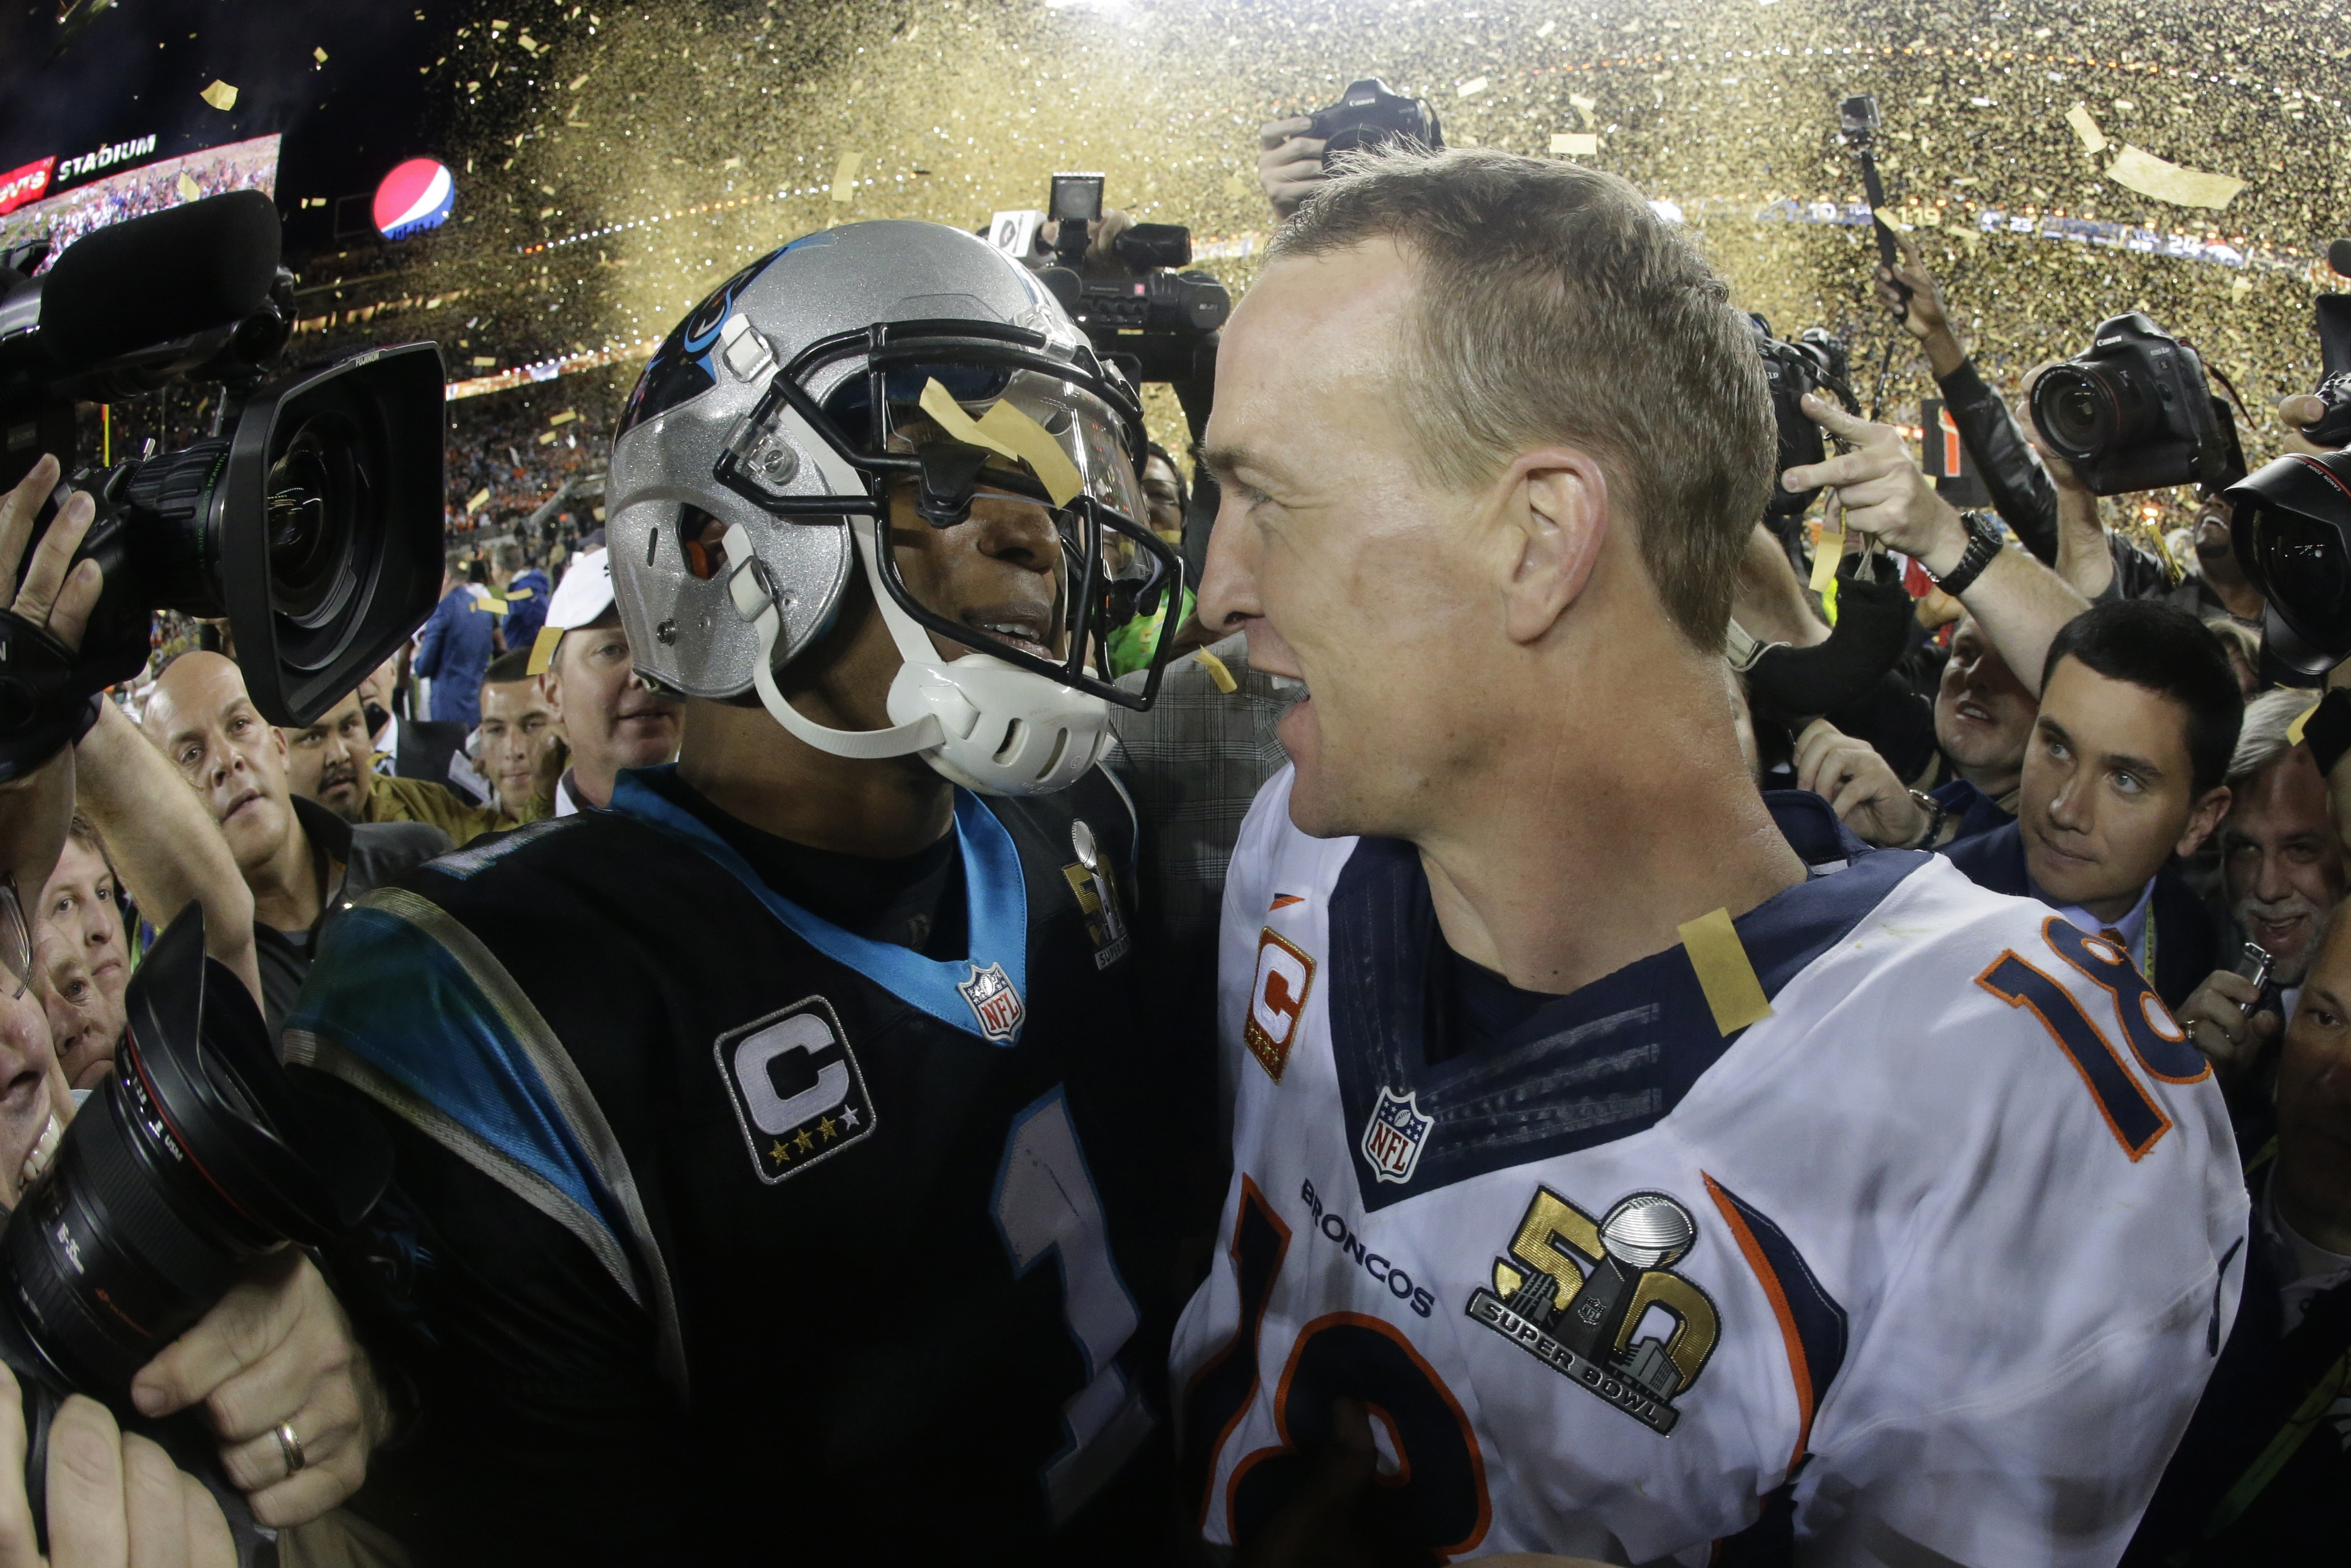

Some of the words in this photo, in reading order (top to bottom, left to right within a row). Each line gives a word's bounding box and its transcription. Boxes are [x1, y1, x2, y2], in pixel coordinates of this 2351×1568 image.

[58, 133, 156, 181] STADIUM
[355, 351, 379, 367] FUJINON
[2096, 335, 2122, 347] Canon
[207, 453, 228, 487] FUJINON
[2307, 464, 2323, 475] ZOOM
[2323, 475, 2341, 491] CANON
[981, 992, 1019, 1031] NFL
[1252, 943, 1306, 1044] C
[734, 1013, 850, 1135] C
[1974, 916, 2212, 1163] 18
[1370, 1121, 1410, 1172] NFL
[1300, 1177, 1435, 1318] BRONCOS
[988, 1081, 1157, 1531] 1
[1493, 1185, 1720, 1395] 50
[1186, 1172, 1492, 1565] 18
[1482, 1301, 1575, 1371] SUPER
[1583, 1366, 1659, 1424] BOWL
